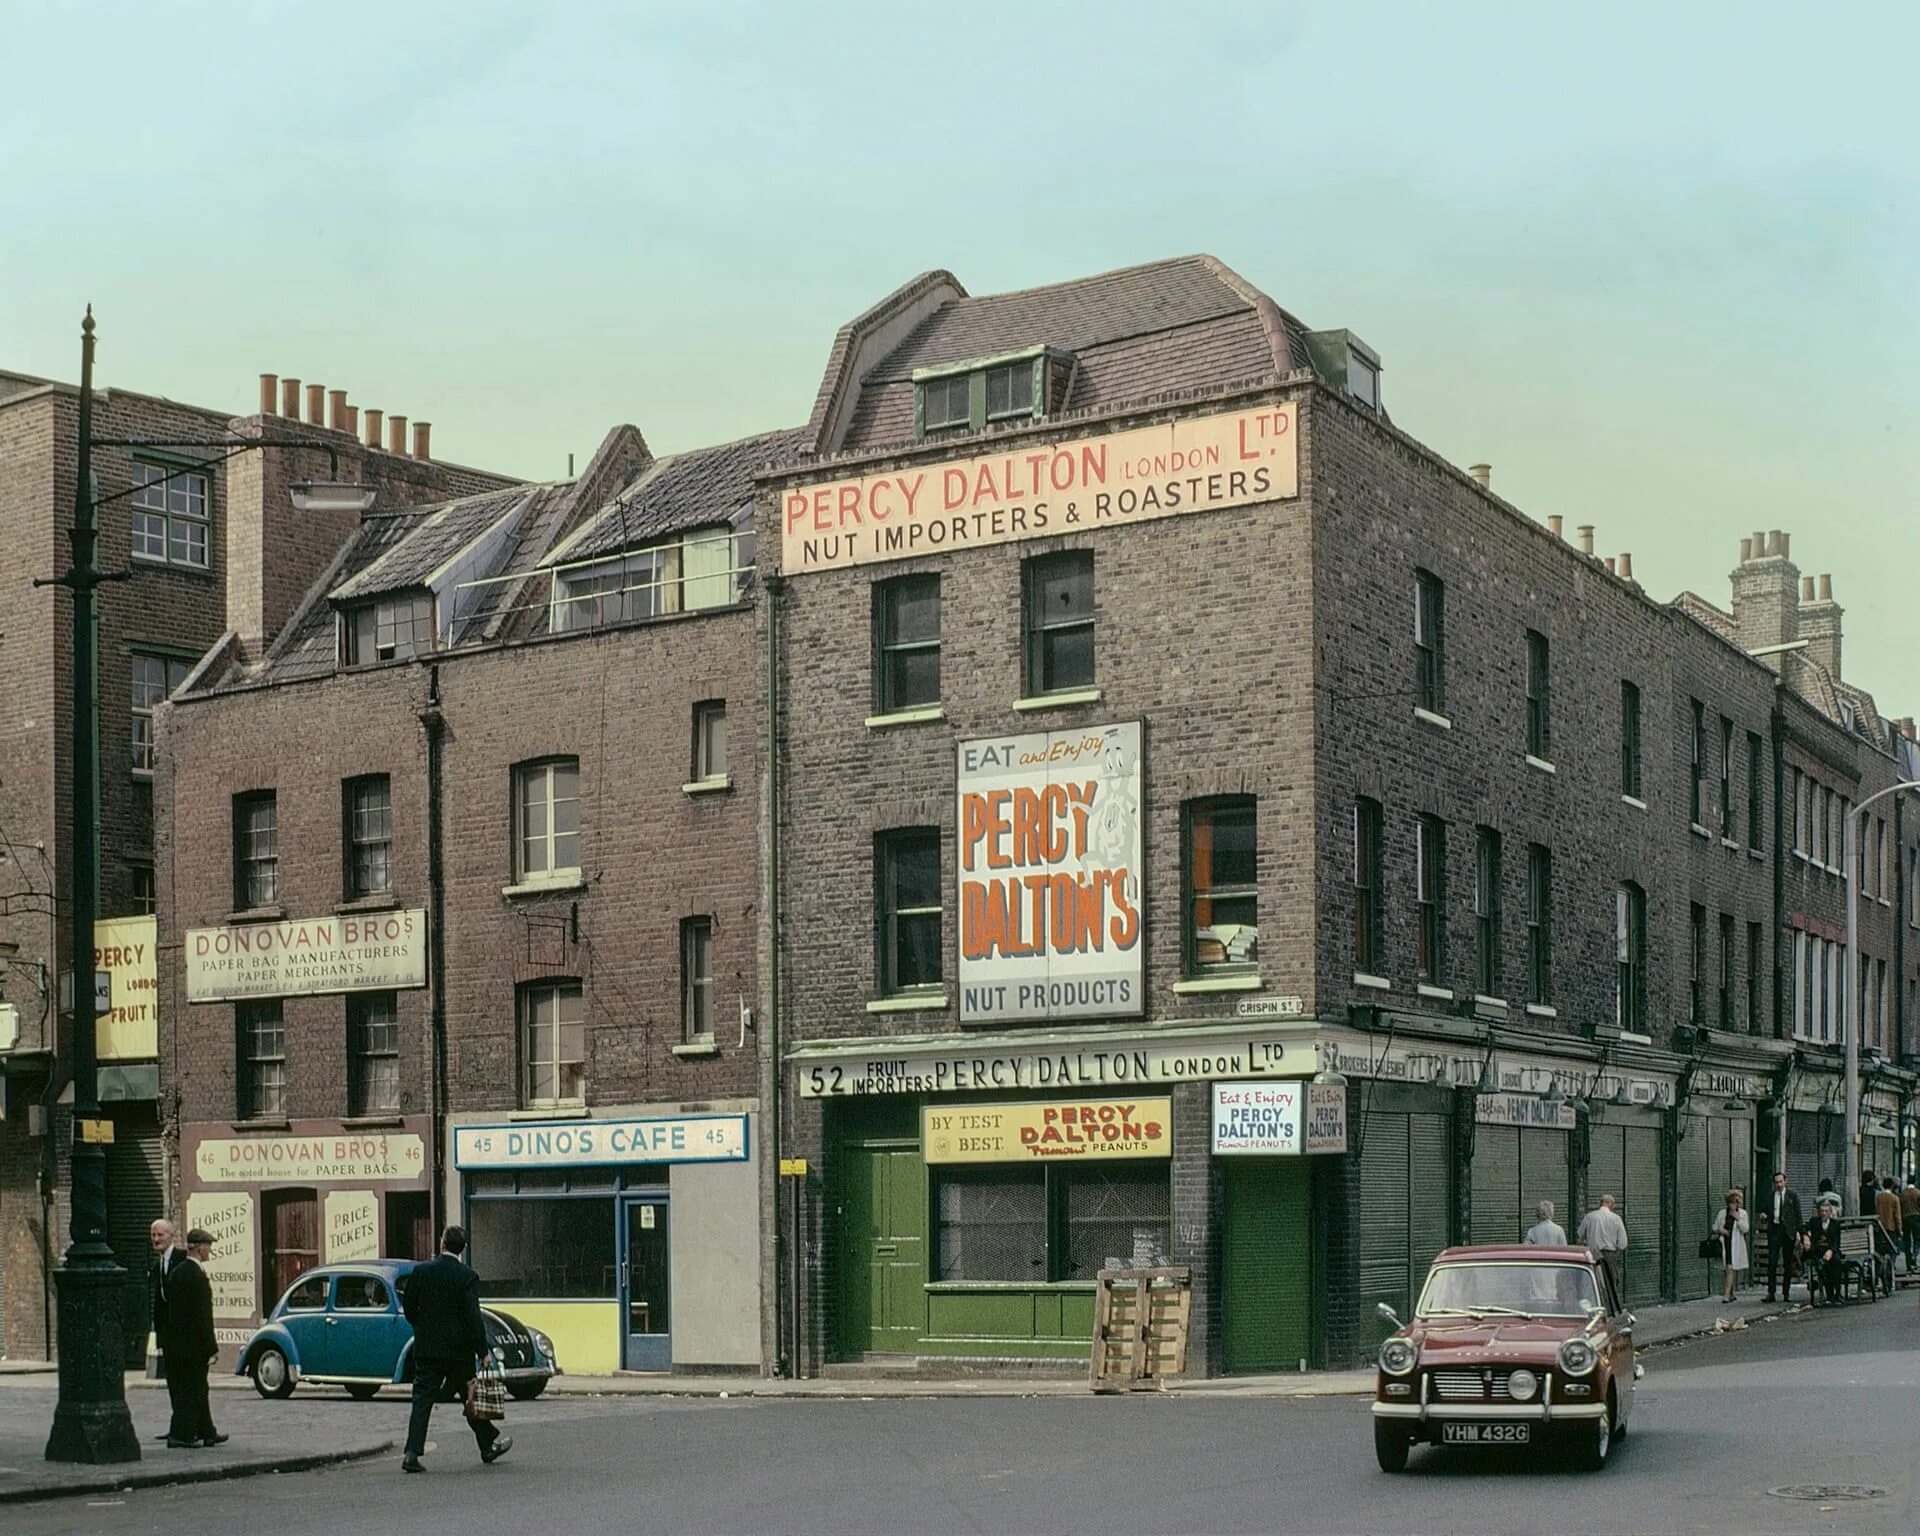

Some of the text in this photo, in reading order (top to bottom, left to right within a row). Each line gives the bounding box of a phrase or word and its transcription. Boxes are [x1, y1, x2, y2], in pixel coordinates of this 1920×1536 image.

[787, 474, 925, 535] PERCY
[943, 444, 1108, 510] DALTON
[1125, 444, 1220, 479] LONDON
[803, 466, 1272, 564] NUT IMPORTERS & ROASTERS
[964, 735, 1104, 772] EAT and Enjoy
[962, 780, 1098, 872] PERCY
[962, 867, 1140, 961] DALTON'S
[196, 925, 332, 956] DONOVAN
[94, 943, 144, 968] PERCY
[202, 945, 408, 971] PAPER BAG MANUFACTURERS
[238, 963, 363, 983] PAPER MERCHANTS
[966, 979, 1131, 1012] NUT PRODUCTS
[111, 1004, 147, 1024] FRUIT
[1240, 1001, 1278, 1013] CRISPIN
[852, 1075, 932, 1095] IMPORTERS
[935, 1058, 1022, 1088] PERCY
[1038, 1052, 1149, 1083] DALTON
[1161, 1056, 1240, 1076] LONDON
[867, 1060, 907, 1077] FRUIT
[811, 1066, 844, 1094] 52
[1220, 1090, 1293, 1107] Eat & Enjoy
[931, 1115, 1003, 1130] BY TEST
[1044, 1105, 1136, 1125] PERCY
[1231, 1108, 1283, 1122] PERCY
[1315, 1107, 1339, 1121] PERCY
[1218, 1123, 1294, 1138] DALTON'S
[1309, 1122, 1343, 1138] DALTON'S
[474, 1126, 724, 1156] 45 DINO'S CAFE 45
[1093, 1141, 1148, 1152] PEANUTS
[1216, 1140, 1292, 1149] Famous PEANUTS
[201, 1153, 215, 1165] 46
[230, 1142, 324, 1162] DONOVAN
[405, 1147, 420, 1160] 46
[220, 1163, 398, 1178] The noted house for PAPER BAGS
[329, 1222, 375, 1249] TICKETS
[209, 1272, 254, 1282] ASEPROOFS
[217, 1330, 250, 1342] RONG
[1445, 1425, 1528, 1441] YHM 432G
